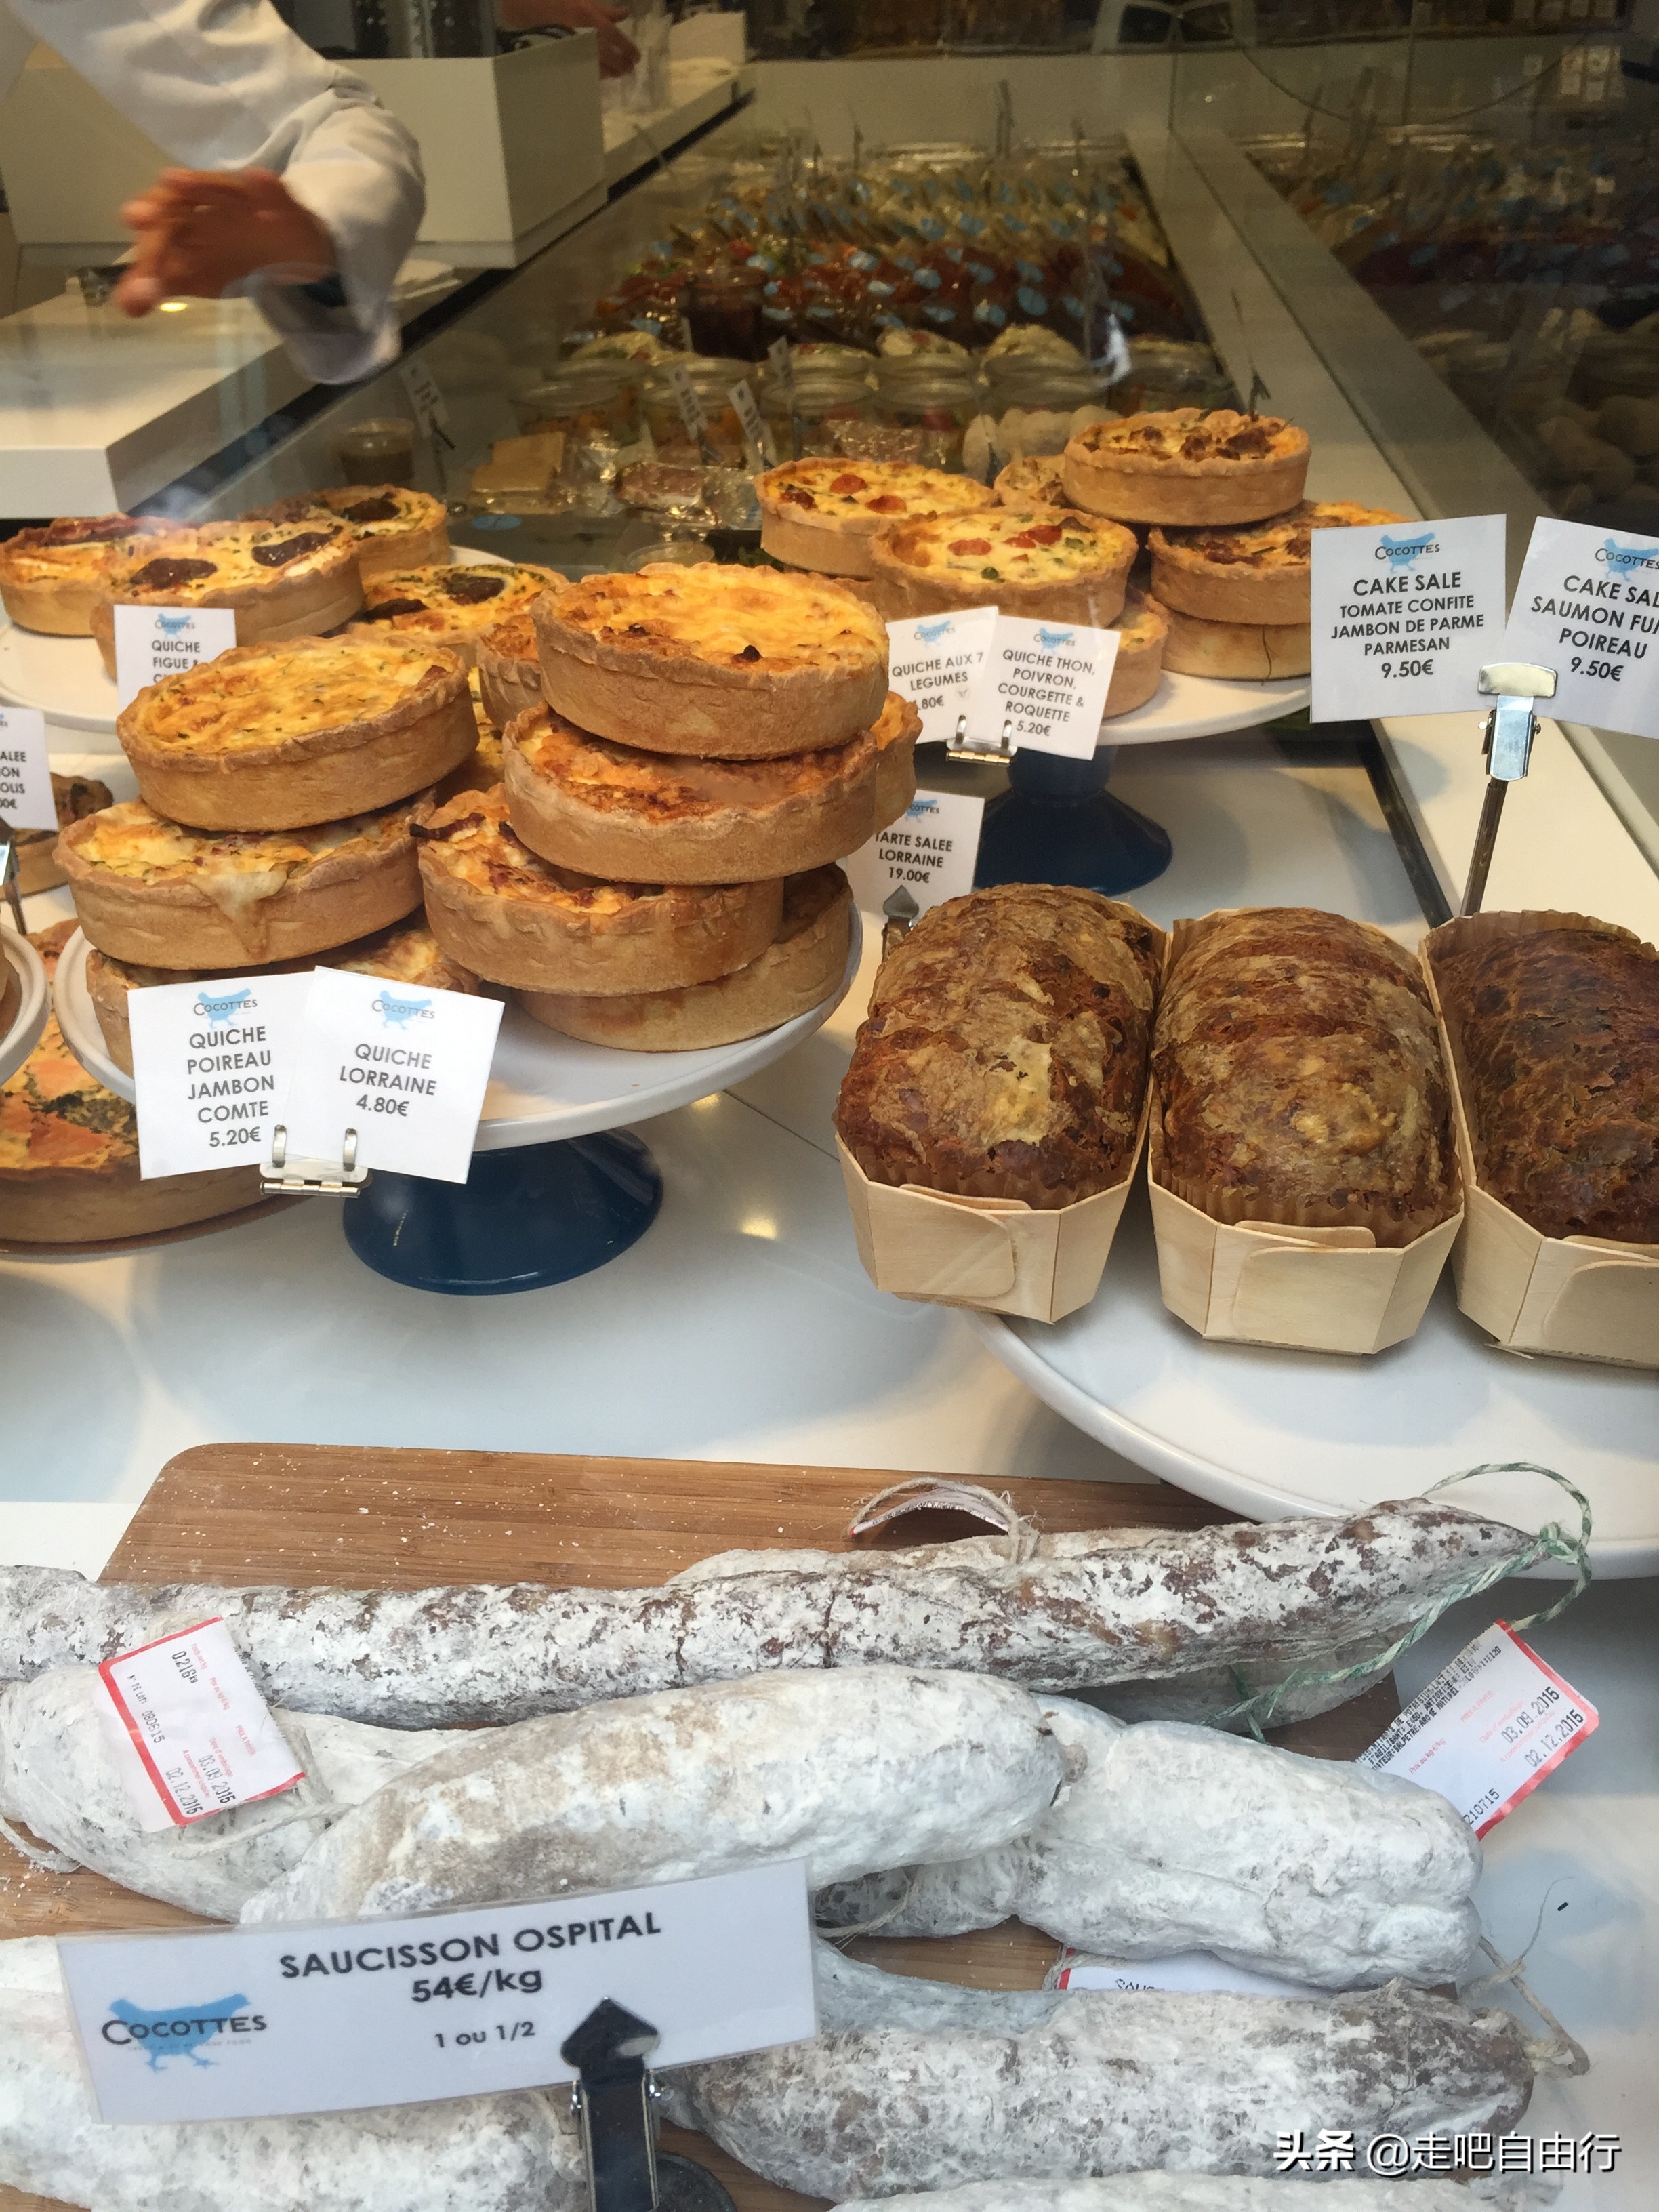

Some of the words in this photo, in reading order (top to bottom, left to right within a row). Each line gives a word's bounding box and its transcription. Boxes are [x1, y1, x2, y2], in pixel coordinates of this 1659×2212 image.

[1374, 544, 1440, 560] COCOTTES
[1353, 576, 1408, 596] CAKE
[1415, 572, 1462, 591] SALE
[1563, 575, 1621, 600] CAKE
[1340, 602, 1403, 618] TOMATE
[1408, 595, 1474, 612] CONFITE
[1531, 596, 1626, 628] SAUMON
[1331, 622, 1399, 638] JAMBON
[1406, 618, 1425, 632] DE
[1430, 615, 1484, 630] PARME
[152, 640, 200, 653] QUICHE
[1364, 637, 1450, 656] PARMESAN
[1559, 628, 1647, 658] POIREAU
[153, 657, 188, 668] FIGUE
[892, 658, 941, 678] QUICHE
[945, 654, 973, 669] AUX
[977, 652, 983, 663] 7
[1002, 649, 1052, 667] QUICHE
[1057, 657, 1095, 675] THON,
[1381, 659, 1433, 679] 9.50€
[1570, 657, 1624, 682] 9.50€
[910, 672, 968, 691] LEGUMES
[1012, 668, 1076, 689] POIVRON,
[913, 695, 944, 710] .80€
[998, 683, 1073, 705] COURGETTE
[1076, 697, 1084, 708] &
[1005, 701, 1070, 722] ROQUETTE
[1017, 721, 1051, 737] 5.20€
[909, 805, 939, 813] COTTES
[915, 836, 952, 852] SALEE
[879, 848, 943, 867] LORRAINE
[889, 867, 930, 884] 19.00€
[193, 998, 258, 1016] COCOTTES
[371, 999, 435, 1020] COCOTTES
[189, 1026, 266, 1049] QUICHE
[188, 1050, 272, 1074] POIREAU
[354, 1043, 433, 1069] QUICHE
[188, 1075, 274, 1100] JAMBON
[340, 1065, 438, 1096] LORRAINE
[198, 1101, 269, 1123] COMTE
[356, 1095, 410, 1117] 4.80€
[209, 1126, 262, 1147] 5.20€
[141, 1708, 165, 1744] 080615
[1500, 1685, 1561, 1744] 03.09.2015
[1523, 1708, 1585, 1769] 02.12.2015
[280, 1933, 501, 1979] SAUCISSON
[514, 1911, 662, 1952] OSPITAL
[411, 1968, 542, 2003] 54€/kg
[102, 2015, 268, 2045] COCOTTES
[434, 2033, 445, 2048] 1
[455, 2031, 487, 2045] ou
[496, 2021, 535, 2041] 1/2
